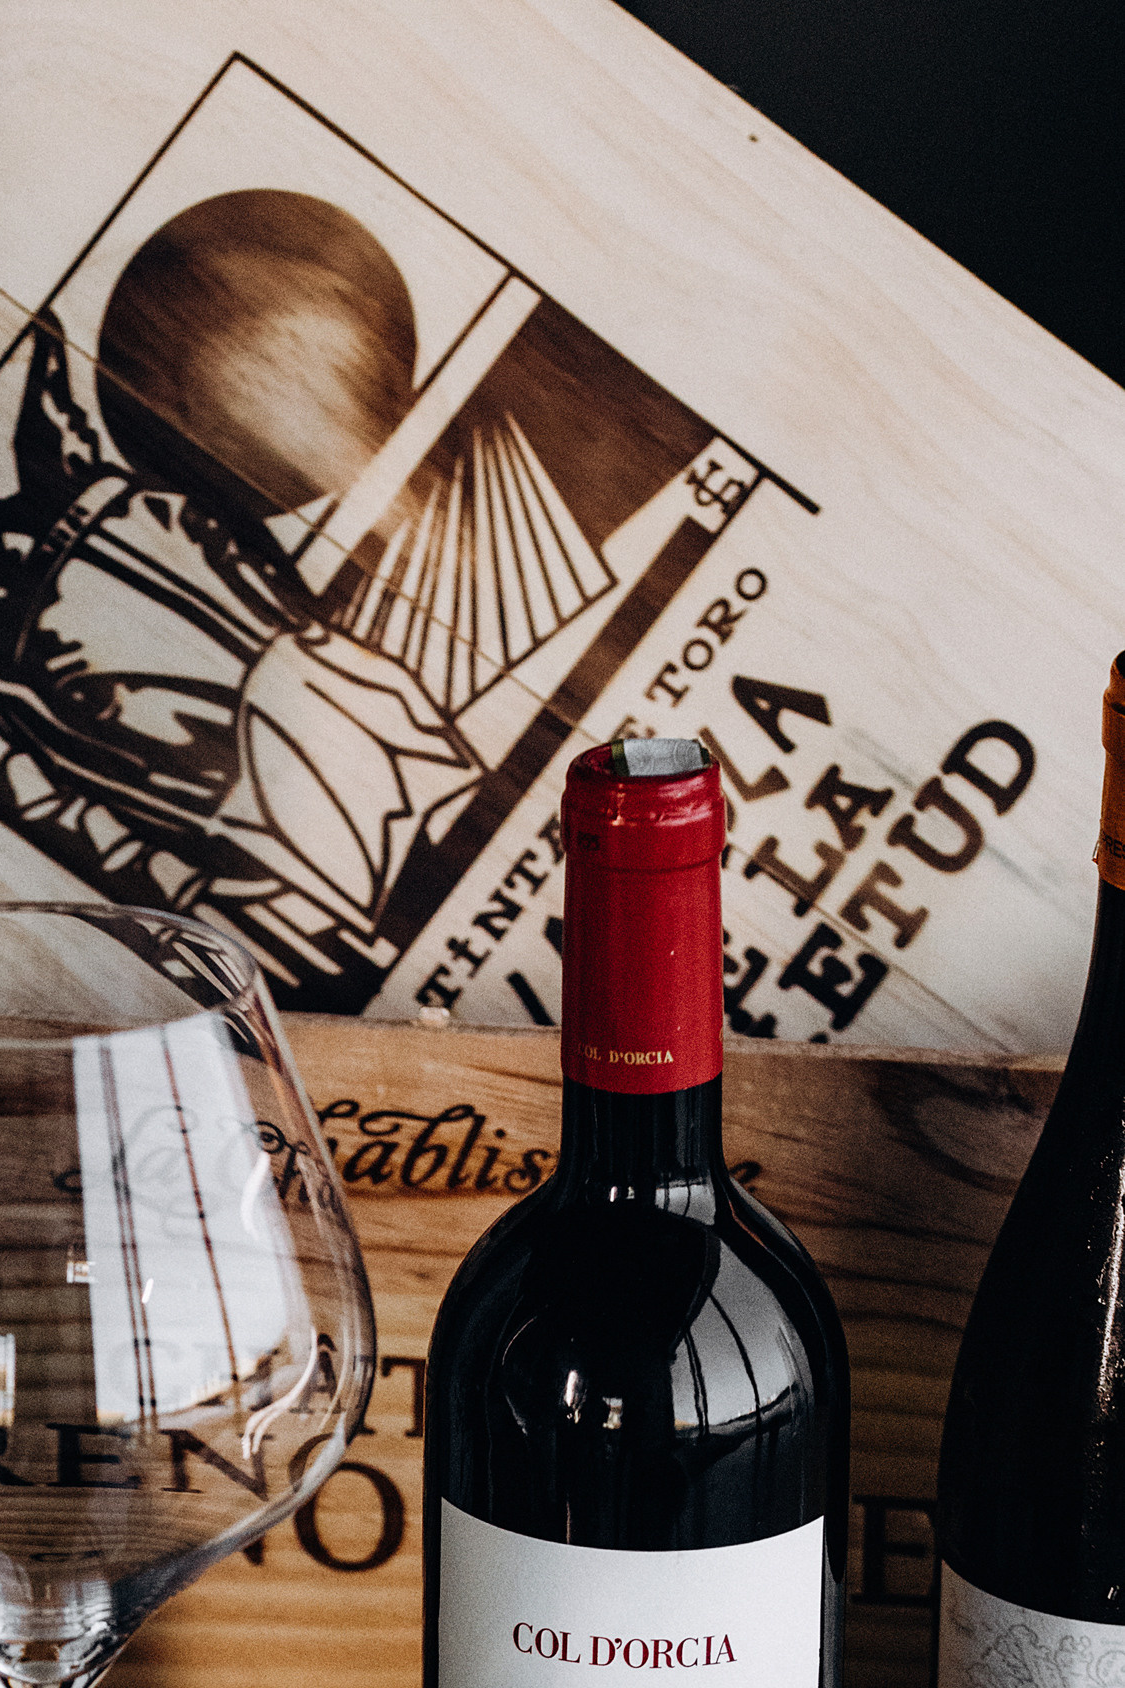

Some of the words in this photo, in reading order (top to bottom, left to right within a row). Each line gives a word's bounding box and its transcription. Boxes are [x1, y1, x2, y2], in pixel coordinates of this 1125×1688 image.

[743, 762, 897, 918] LA
[608, 1049, 675, 1066] D'ORCIA
[512, 1622, 581, 1664] COL
[588, 1633, 738, 1669] D'ORCIA
